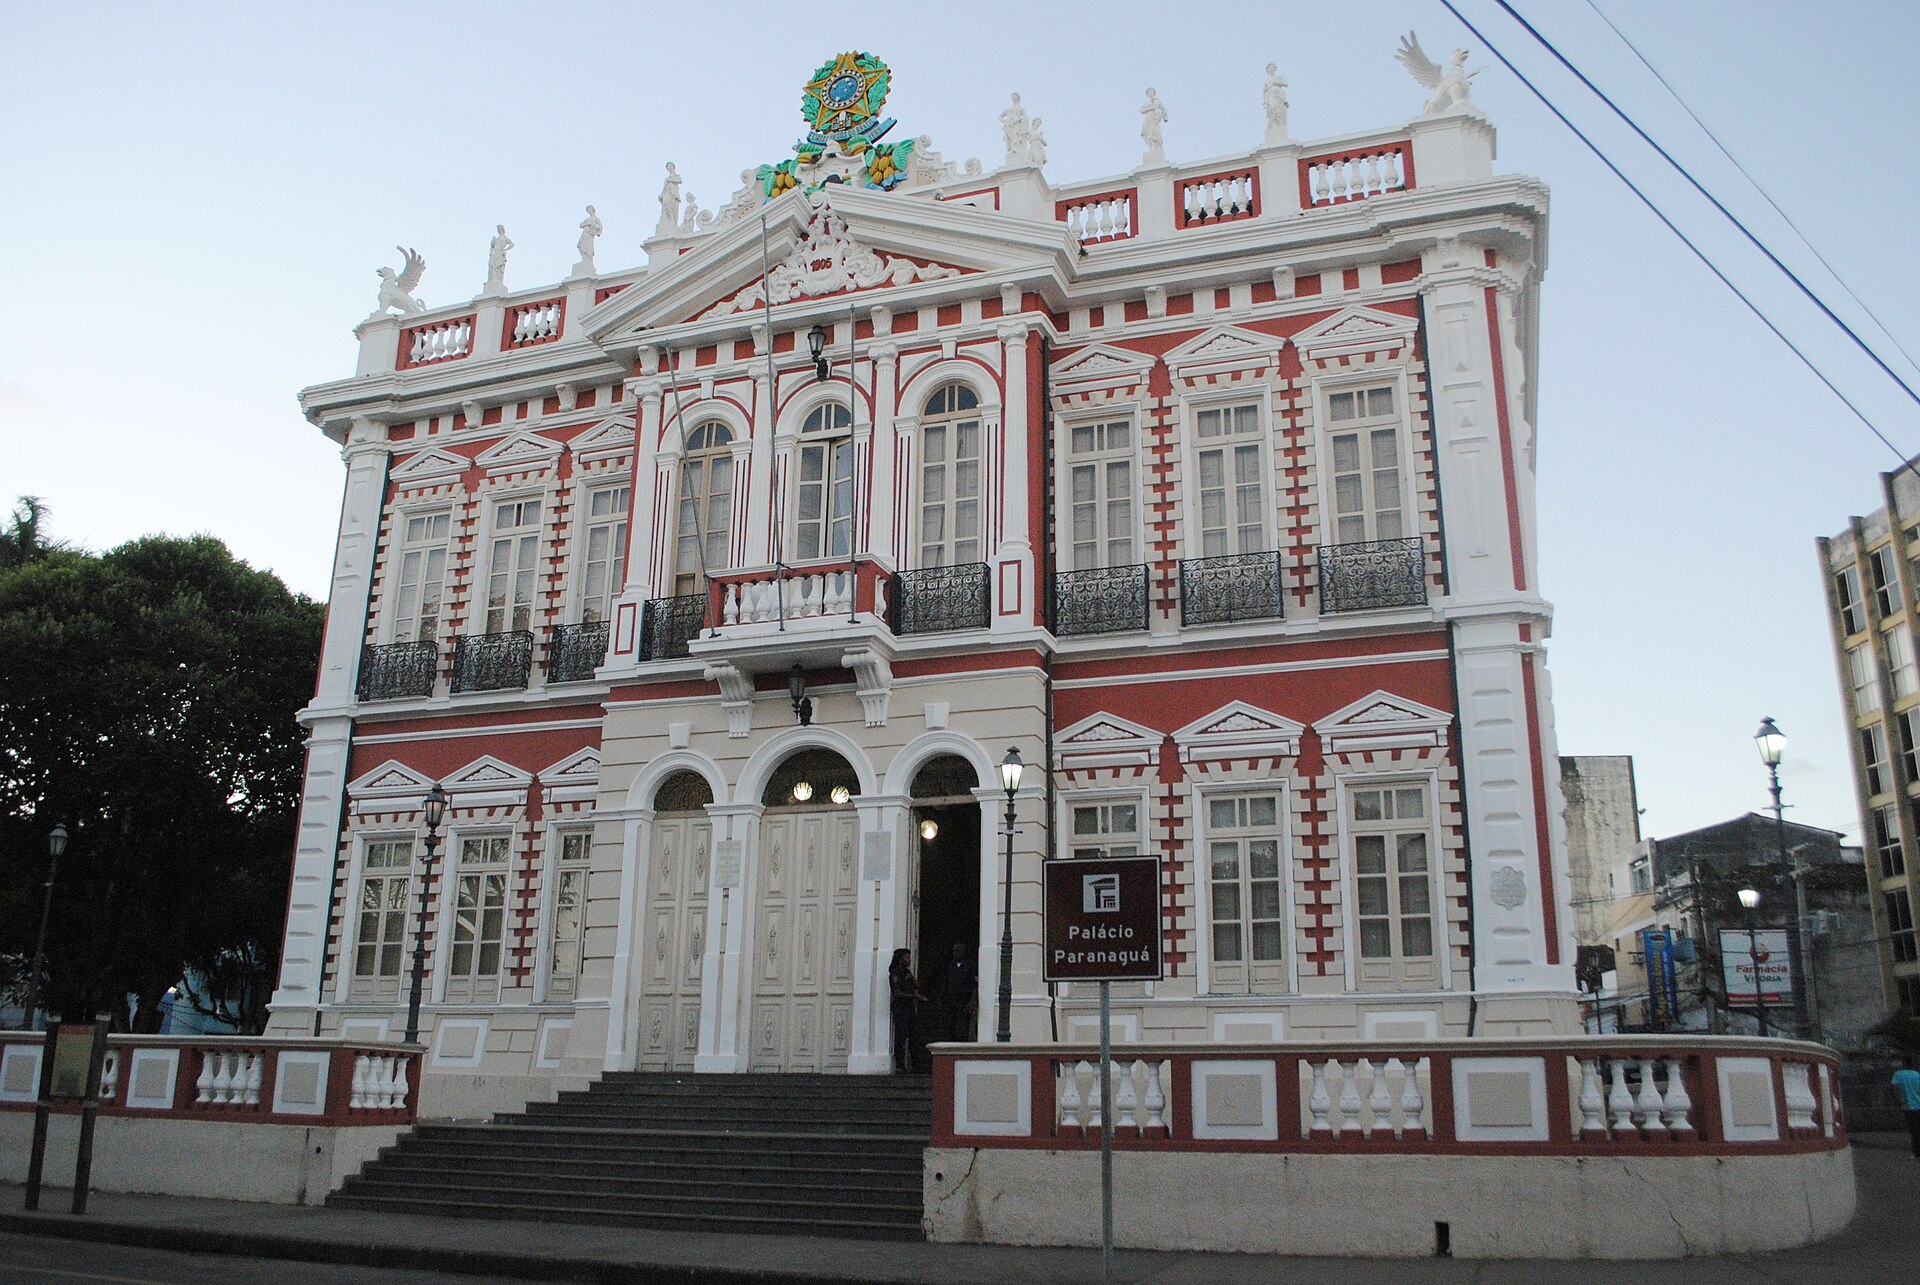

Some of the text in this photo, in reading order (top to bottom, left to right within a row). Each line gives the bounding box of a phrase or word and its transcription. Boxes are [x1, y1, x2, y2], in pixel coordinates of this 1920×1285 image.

[1069, 923, 1134, 940] Palácio
[1055, 945, 1150, 966] Paranaguá
[1744, 974, 1782, 982] VIORIA
